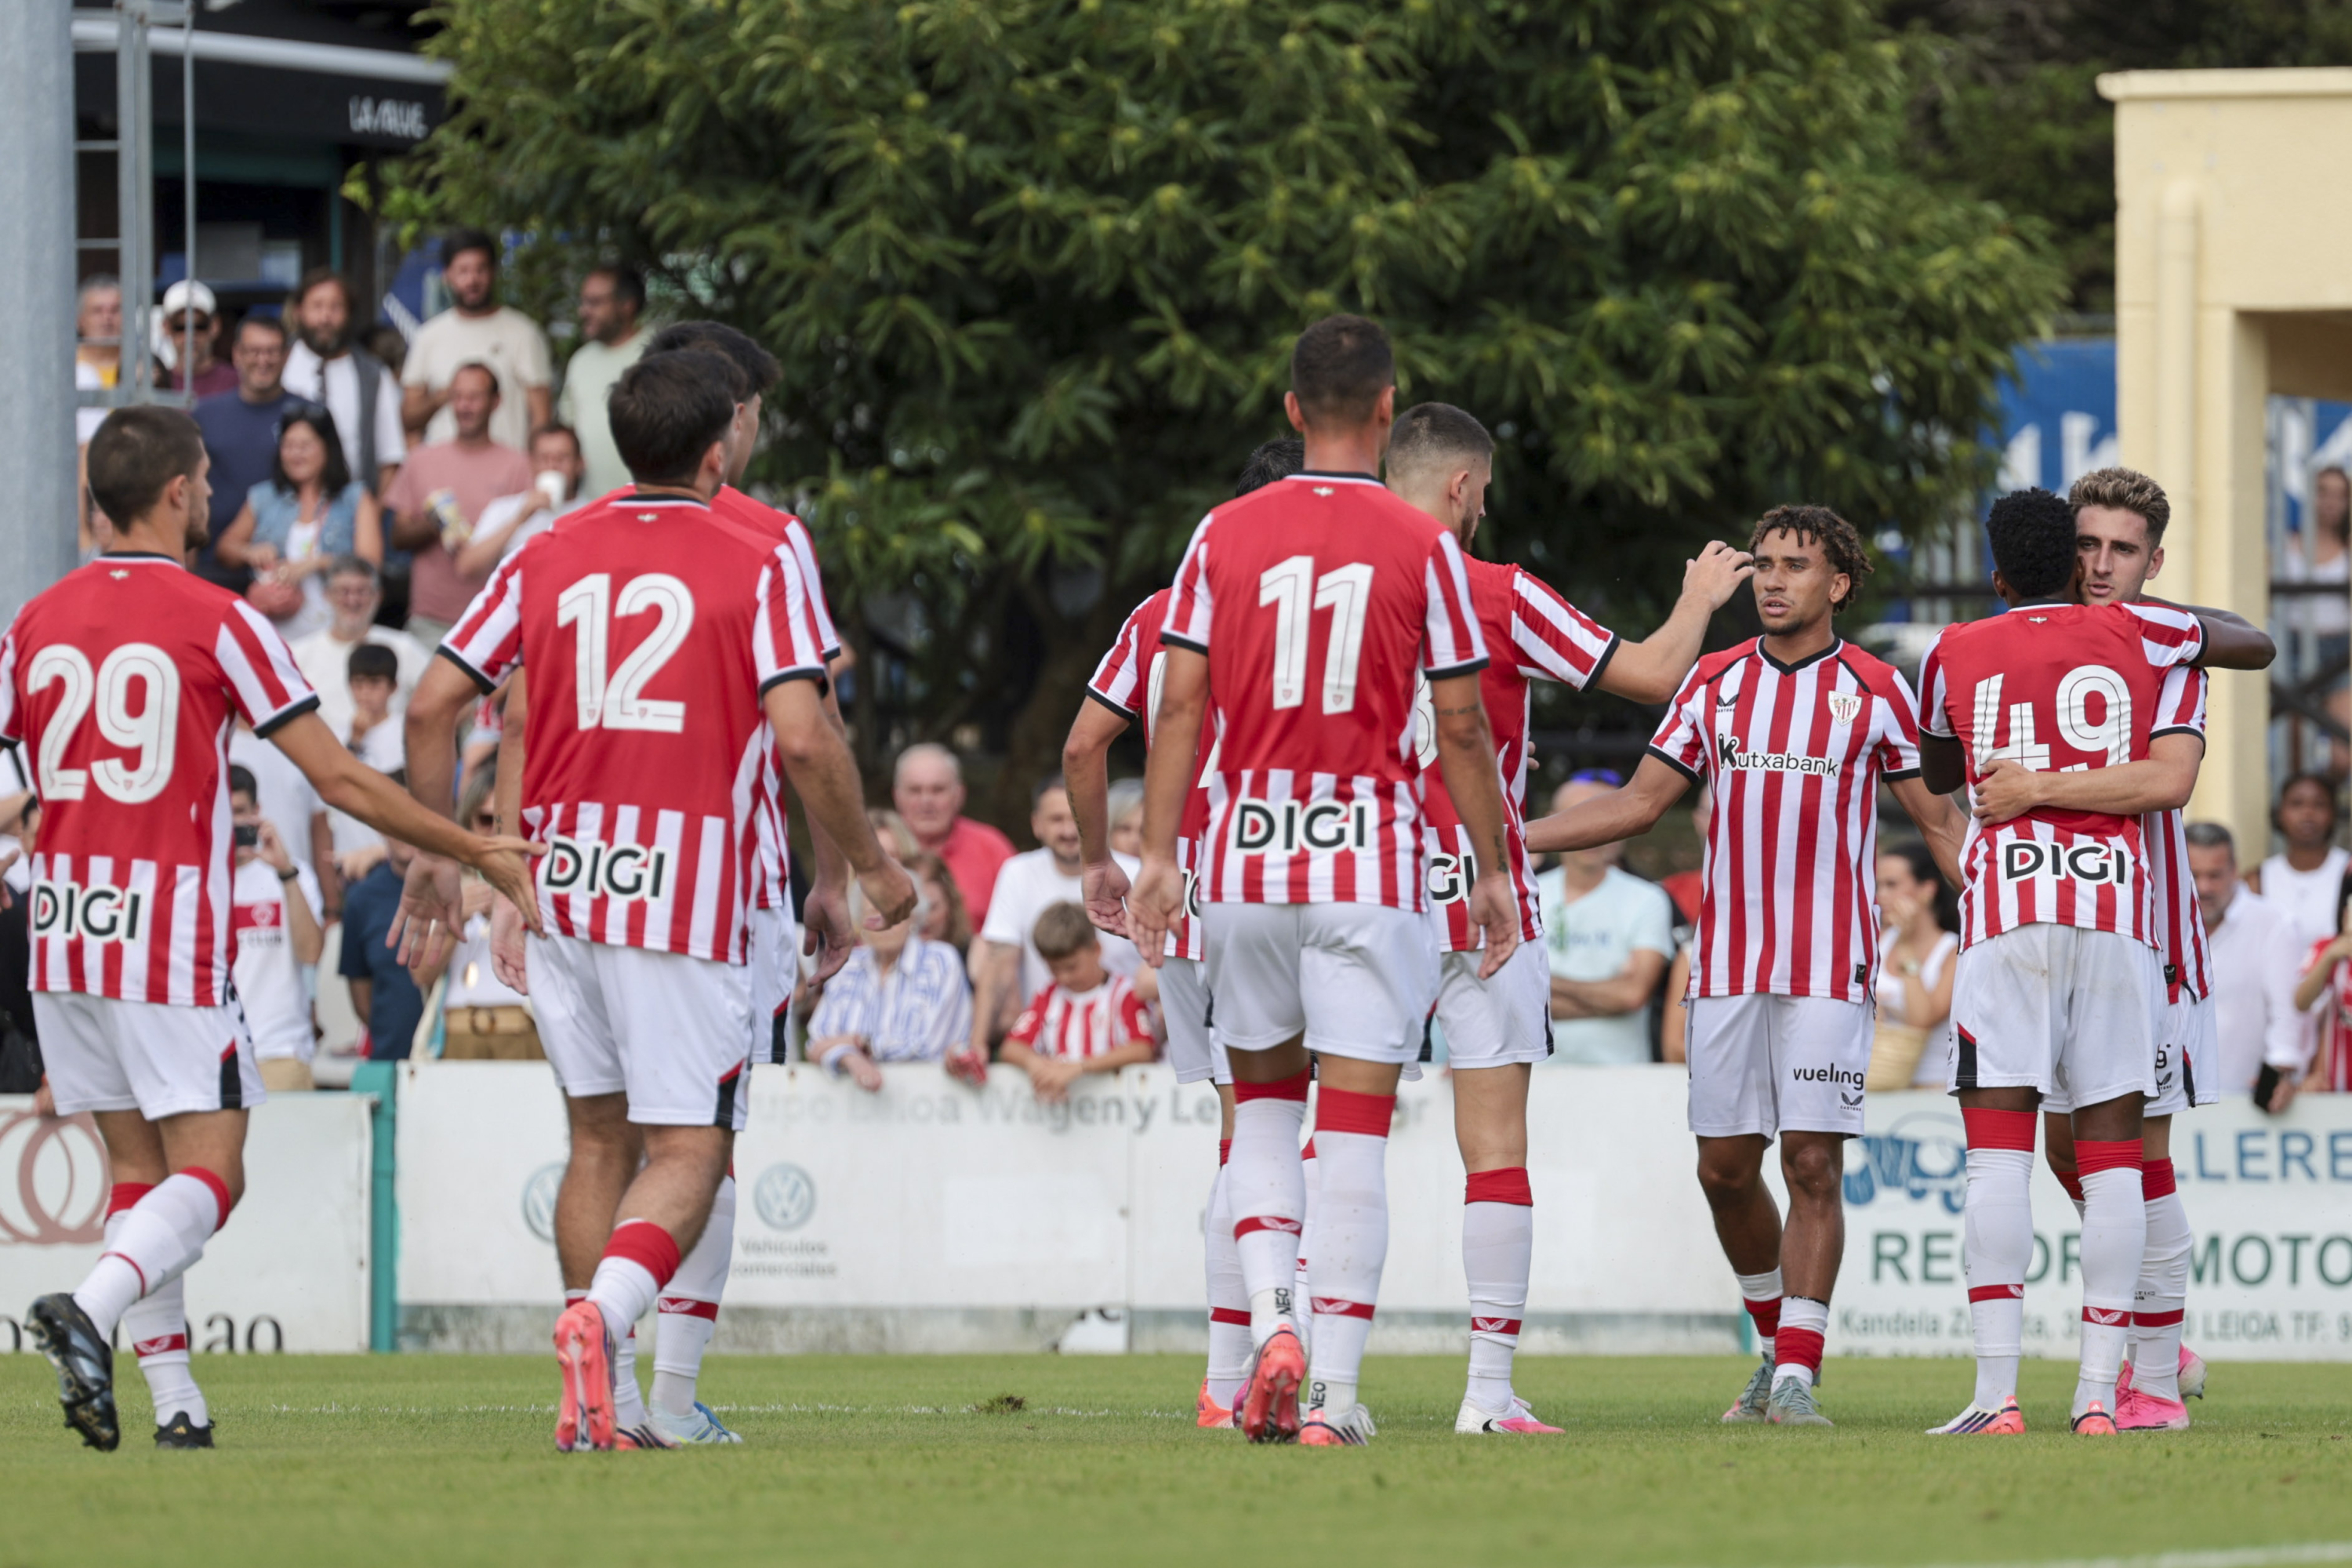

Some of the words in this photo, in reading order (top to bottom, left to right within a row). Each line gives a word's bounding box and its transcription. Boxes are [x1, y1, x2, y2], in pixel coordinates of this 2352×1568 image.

[557, 573, 695, 732] 12
[1259, 555, 1374, 715] 11
[27, 643, 180, 803] 29
[1973, 665, 2132, 778] 49
[1719, 733, 1838, 776] Kutxabank
[1235, 804, 1366, 851] DIGI
[545, 842, 666, 898] DIGI
[1431, 855, 1475, 901] GI
[2005, 842, 2125, 885] DIGI
[34, 884, 140, 940] DIGI
[1793, 1062, 1864, 1091] vueling
[2175, 1128, 2352, 1182] LERE
[1276, 1287, 1292, 1317] NEO
[1838, 1308, 1940, 1337] Kandela
[2202, 1311, 2282, 1341] LEIOA
